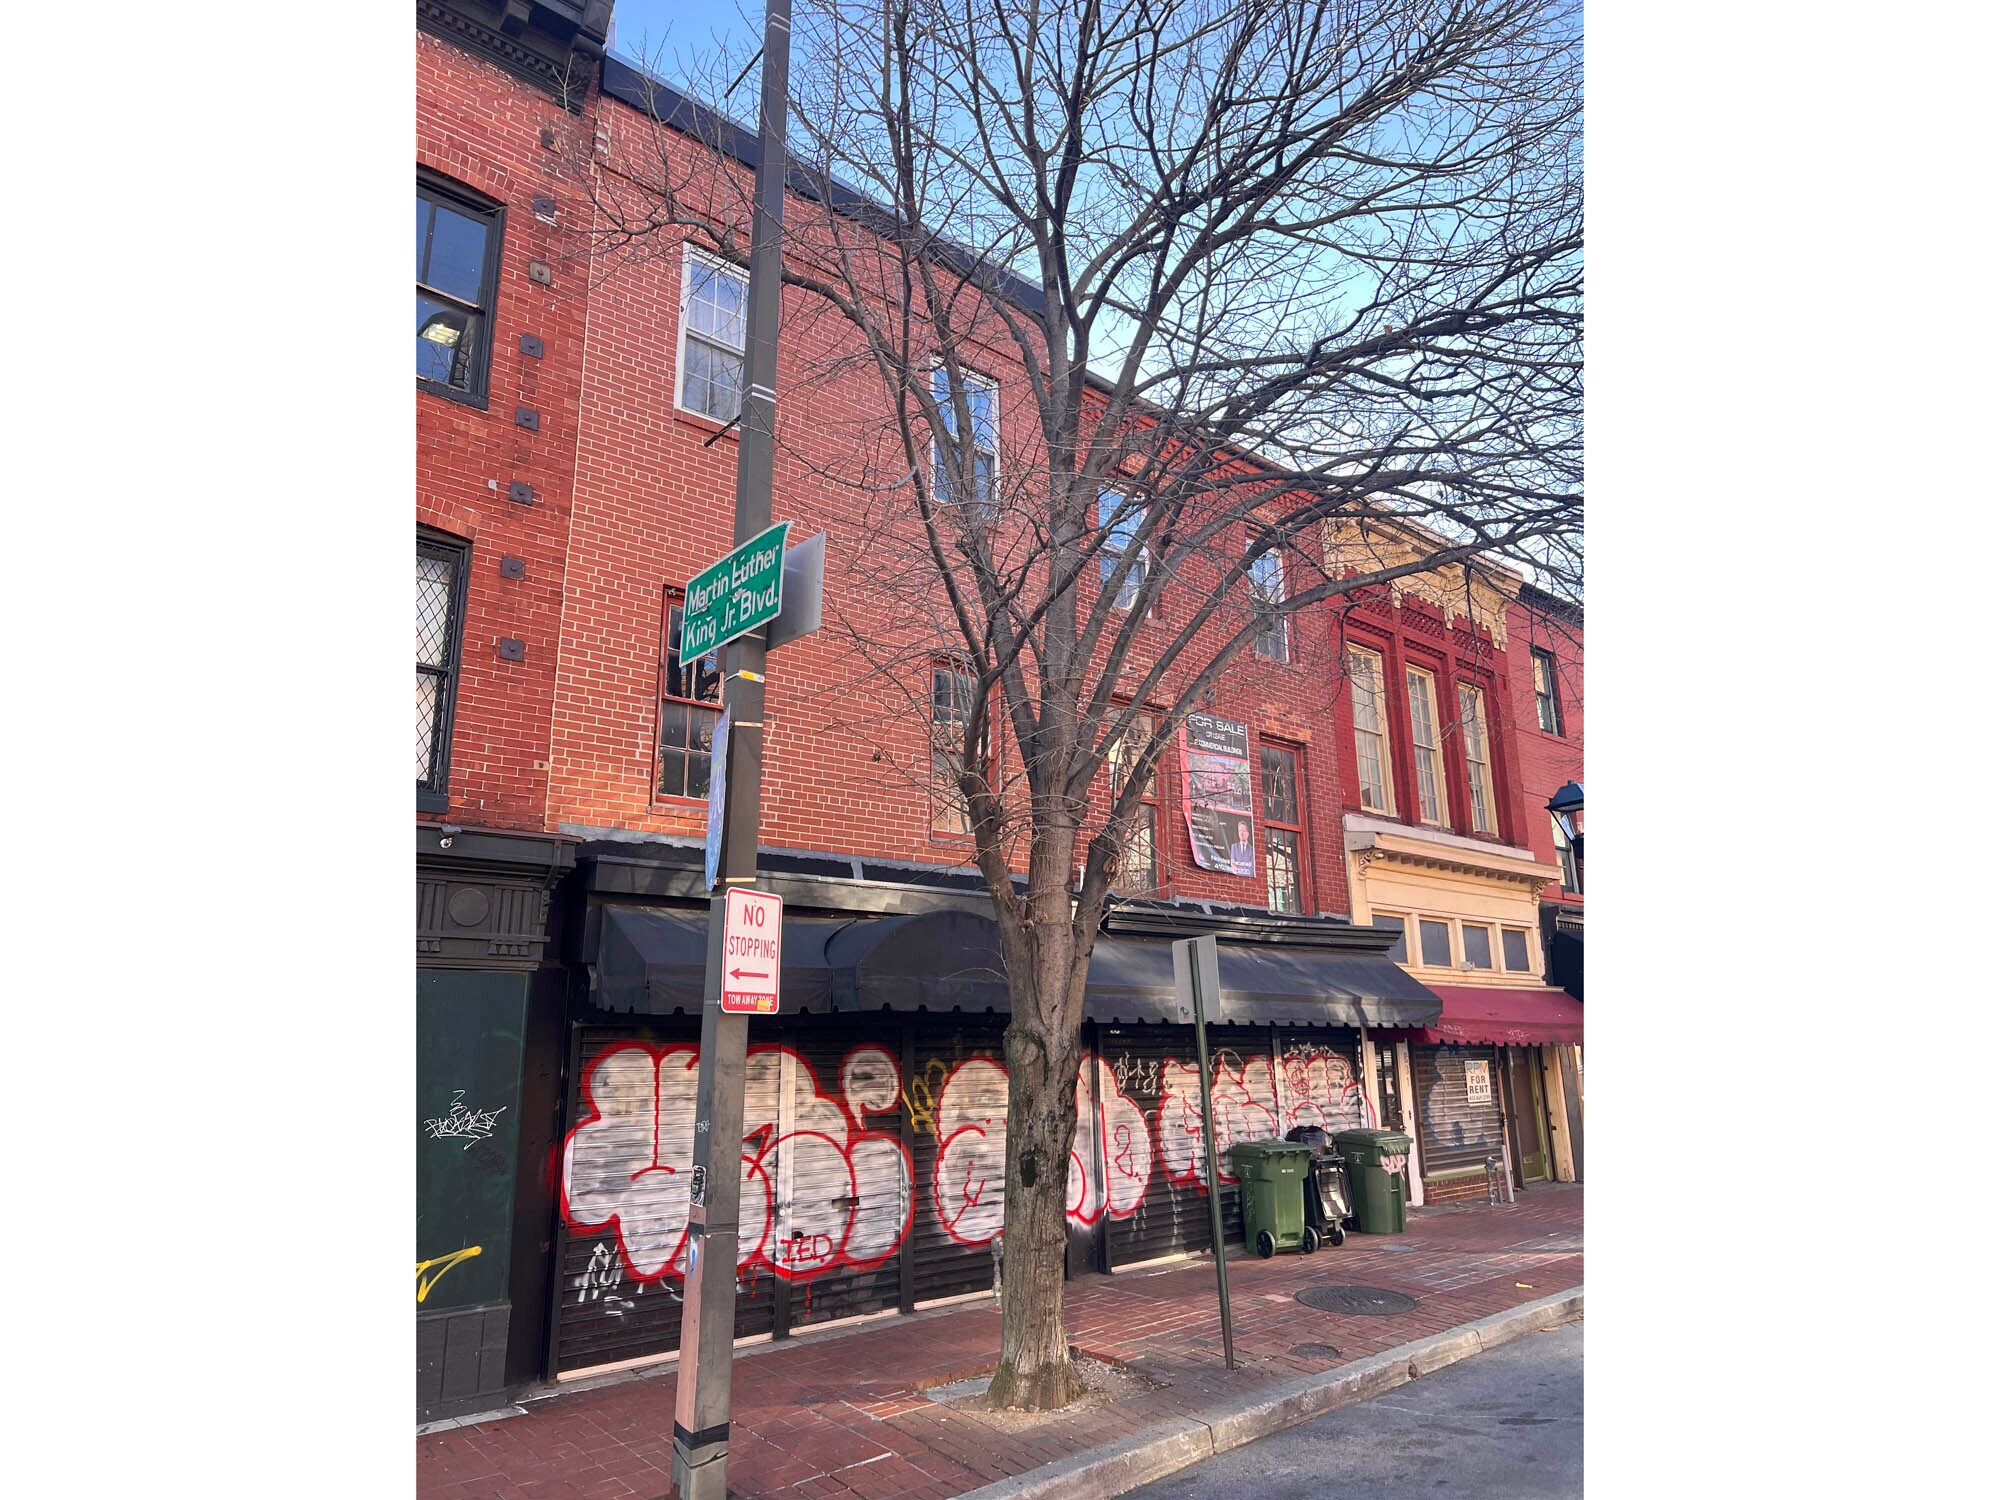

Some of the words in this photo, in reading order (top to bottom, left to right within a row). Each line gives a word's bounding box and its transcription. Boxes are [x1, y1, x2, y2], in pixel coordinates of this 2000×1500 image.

[687, 571, 729, 616] Martin
[731, 546, 780, 589] Luther
[685, 617, 717, 653] King
[720, 603, 737, 633] Jr.
[739, 578, 778, 623] Blvd.
[1188, 714, 1213, 729] FOR
[1215, 720, 1245, 737] SALE
[743, 904, 765, 927] NO
[728, 935, 776, 960] STOPPING
[727, 994, 740, 1005] TOW
[741, 994, 757, 1006] AWAY
[1469, 1085, 1489, 1095] RENT
[1470, 1075, 1486, 1084] FOR
